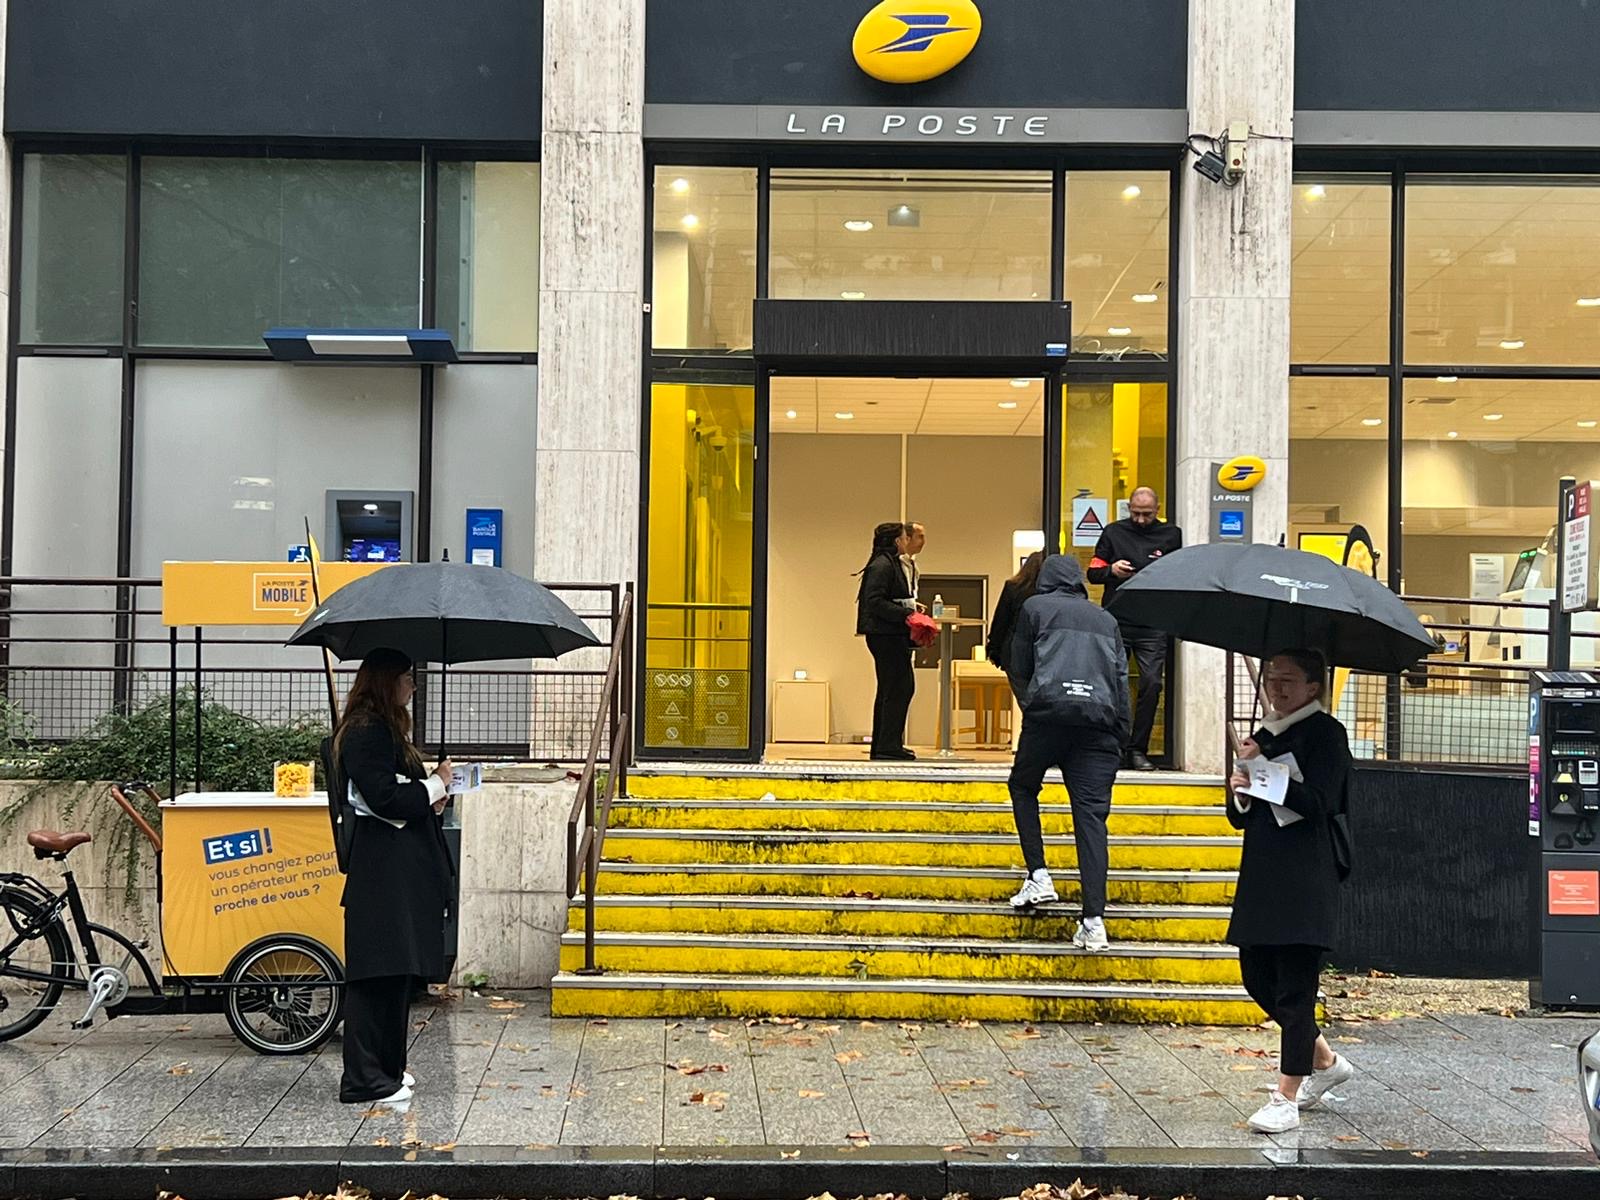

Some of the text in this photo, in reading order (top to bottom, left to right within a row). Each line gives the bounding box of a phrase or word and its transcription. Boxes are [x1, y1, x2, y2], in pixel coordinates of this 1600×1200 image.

[786, 113, 1049, 136] LA POSTE
[1213, 494, 1250, 502] LA POSTE
[1567, 493, 1575, 518] P
[1530, 697, 1537, 728] P
[207, 840, 235, 861] Et
[239, 834, 259, 855] si
[209, 866, 241, 881] vous
[242, 856, 303, 876] changiez
[211, 886, 228, 898] un
[231, 873, 299, 895] opérateur
[213, 896, 259, 916] proche
[261, 892, 278, 905] de
[279, 887, 310, 901] vous
